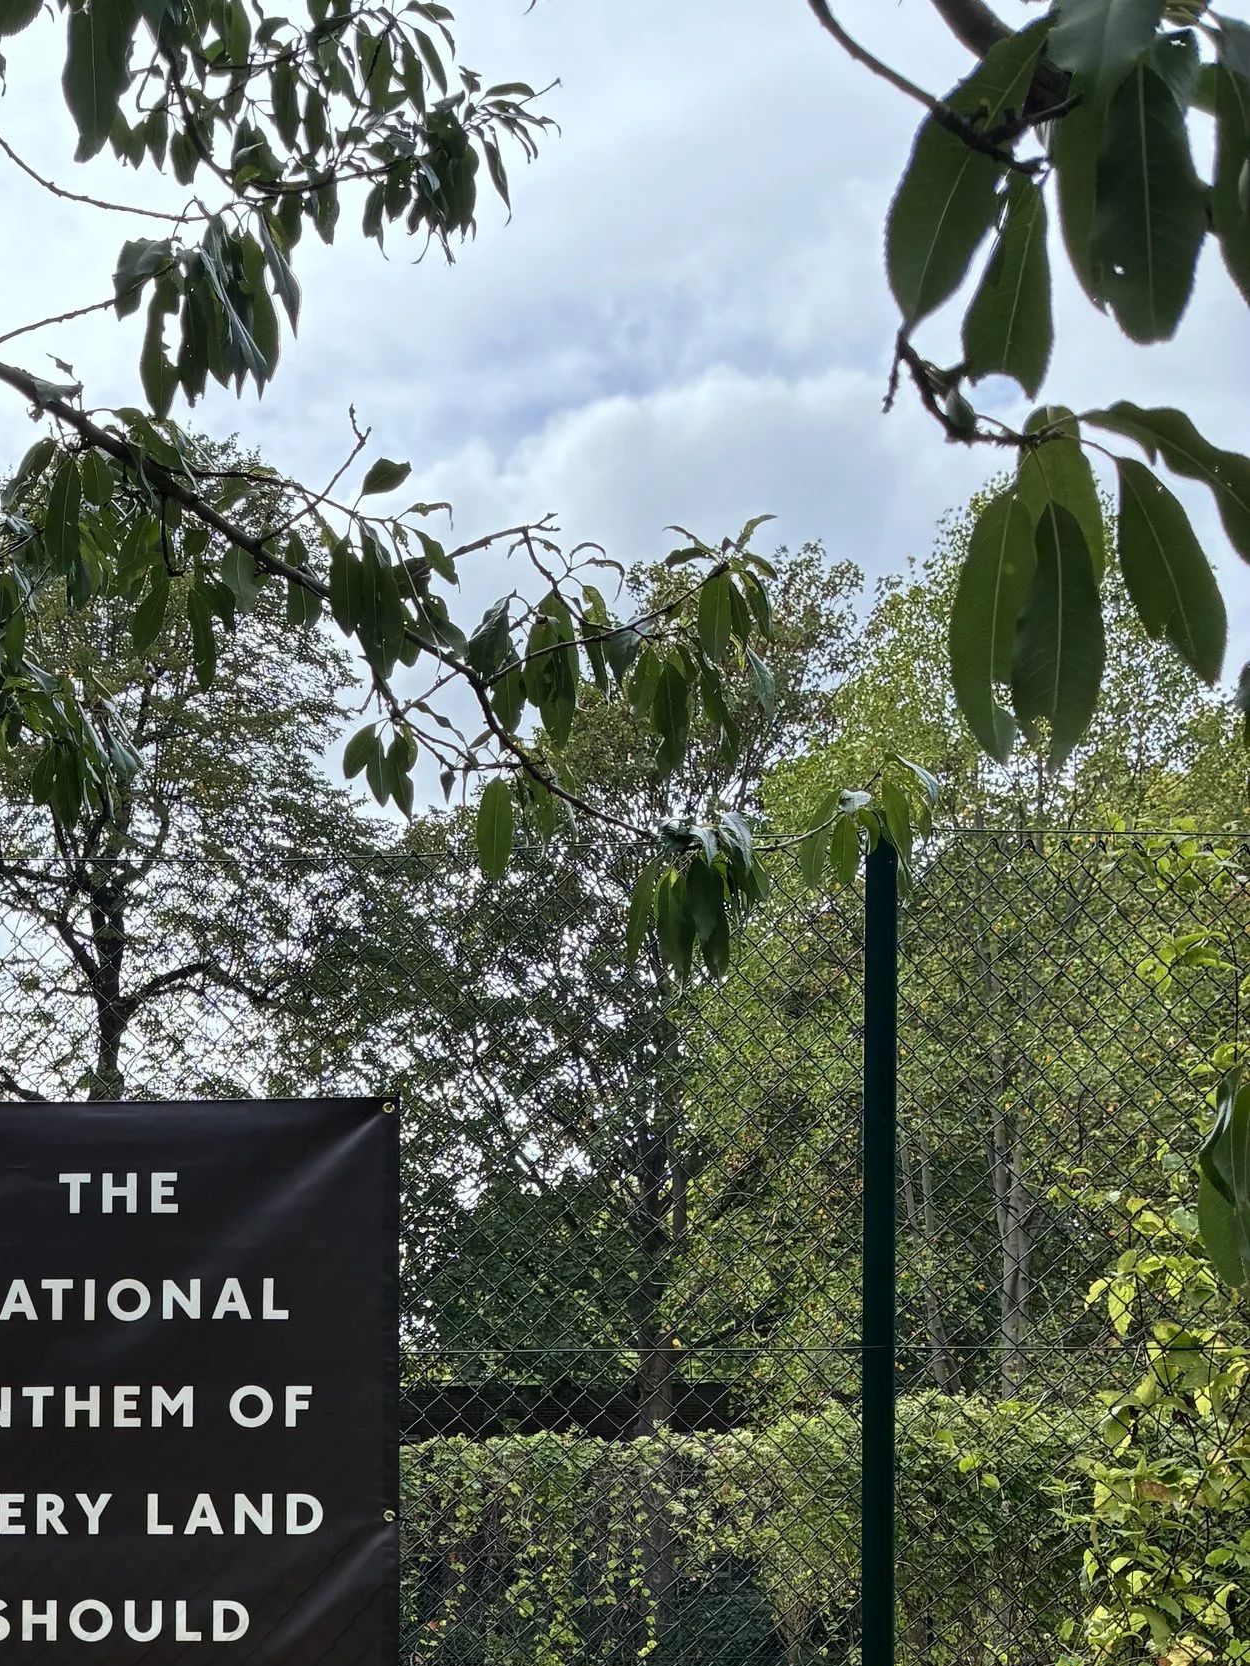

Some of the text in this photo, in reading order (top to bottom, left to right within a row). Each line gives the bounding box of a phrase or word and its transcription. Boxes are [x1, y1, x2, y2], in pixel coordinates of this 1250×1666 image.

[58, 1172, 180, 1214] THE
[229, 1385, 314, 1429] OF
[147, 1493, 325, 1535] LAND
